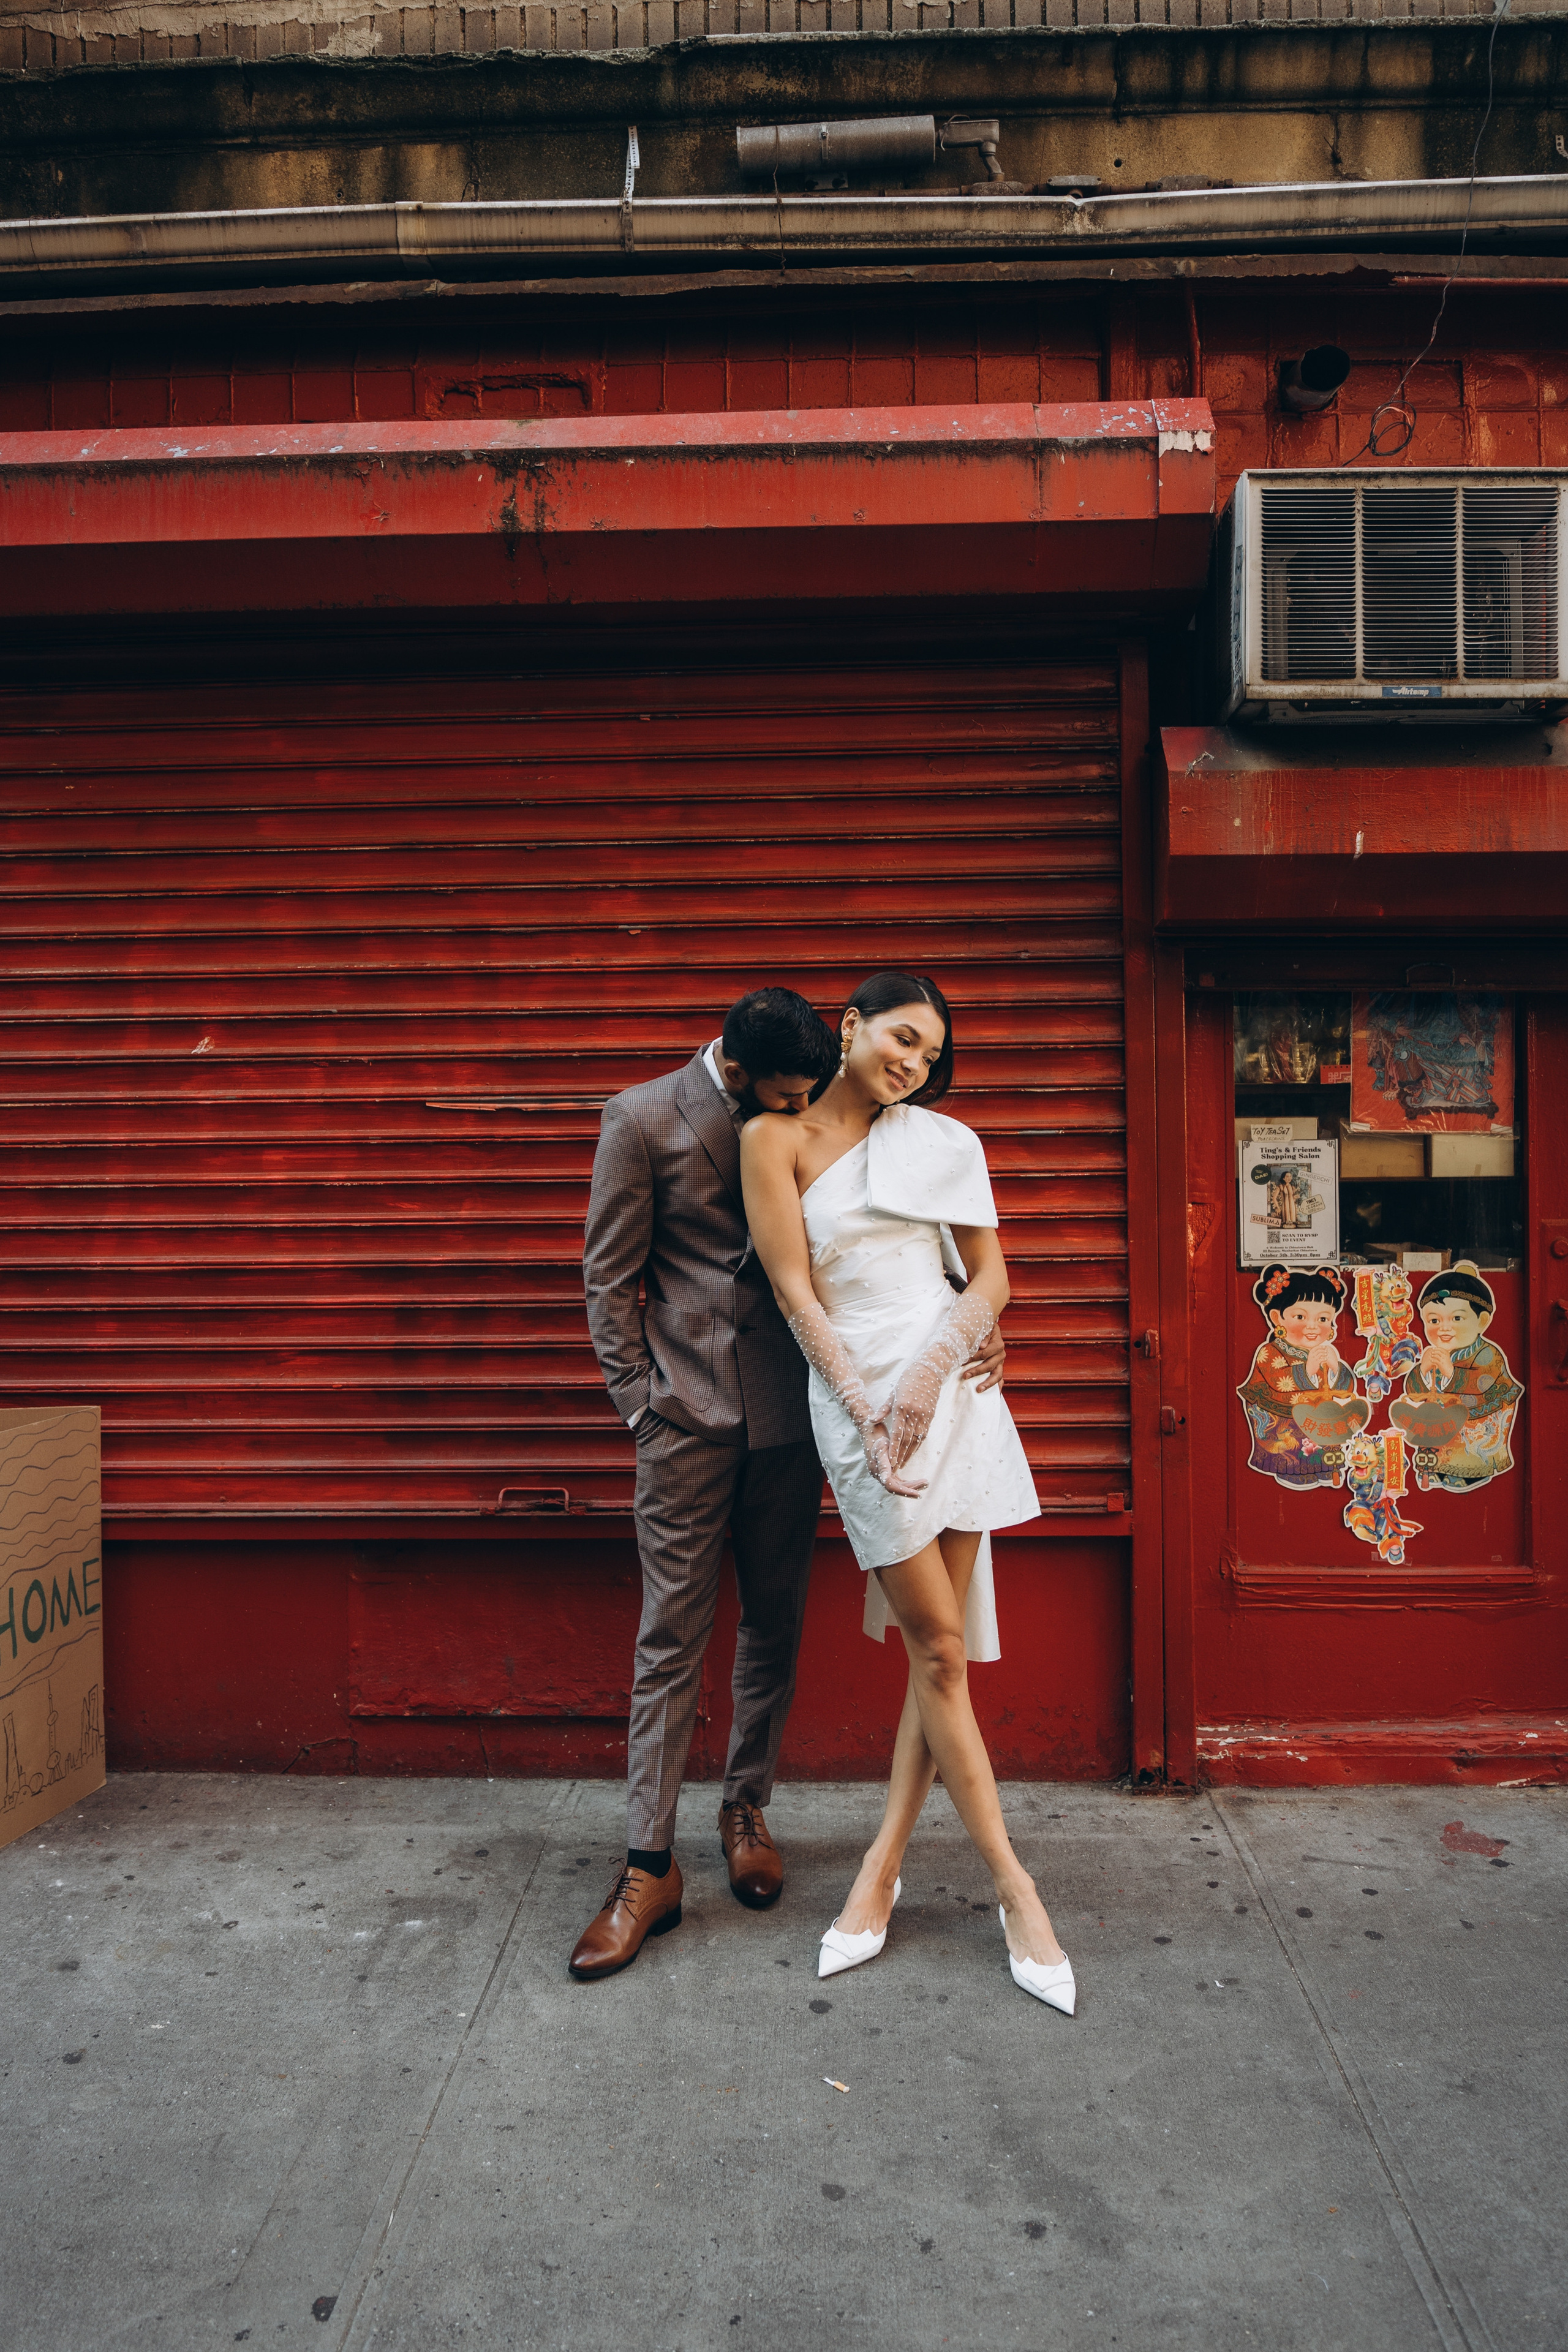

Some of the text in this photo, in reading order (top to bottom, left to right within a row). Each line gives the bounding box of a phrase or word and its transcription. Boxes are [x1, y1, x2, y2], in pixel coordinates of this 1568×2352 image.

[1392, 687, 1429, 697] Airtemp
[1300, 1172, 1330, 1183] GINGERCHI
[1360, 1278, 1374, 1324] 吉星高照
[1387, 1440, 1400, 1486] 富貴平安
[0, 1558, 101, 1666] HOME
